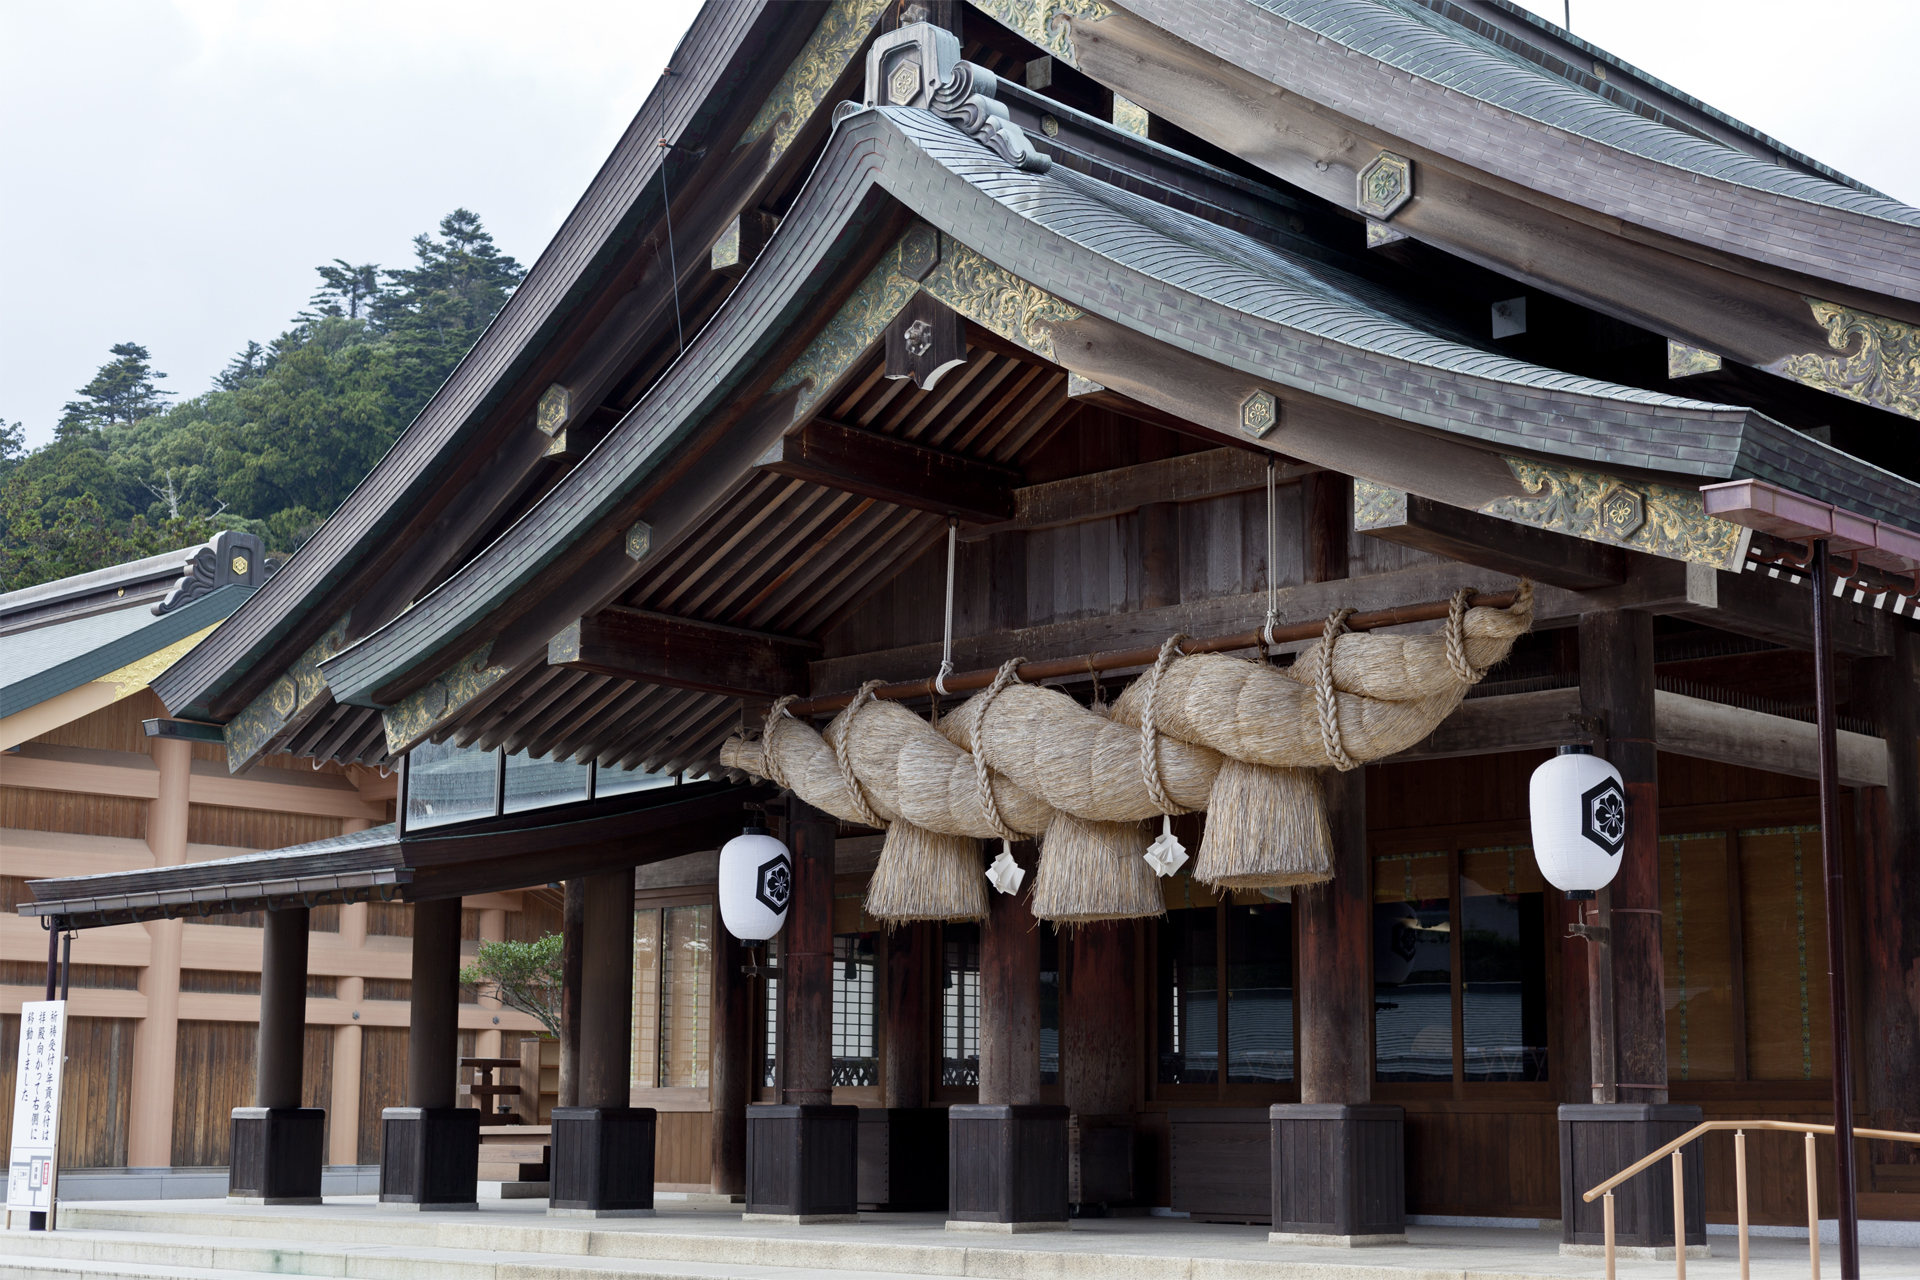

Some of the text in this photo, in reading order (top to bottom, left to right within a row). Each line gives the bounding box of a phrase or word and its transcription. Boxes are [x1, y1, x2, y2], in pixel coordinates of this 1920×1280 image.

[21, 1011, 35, 1102] 移動しました
